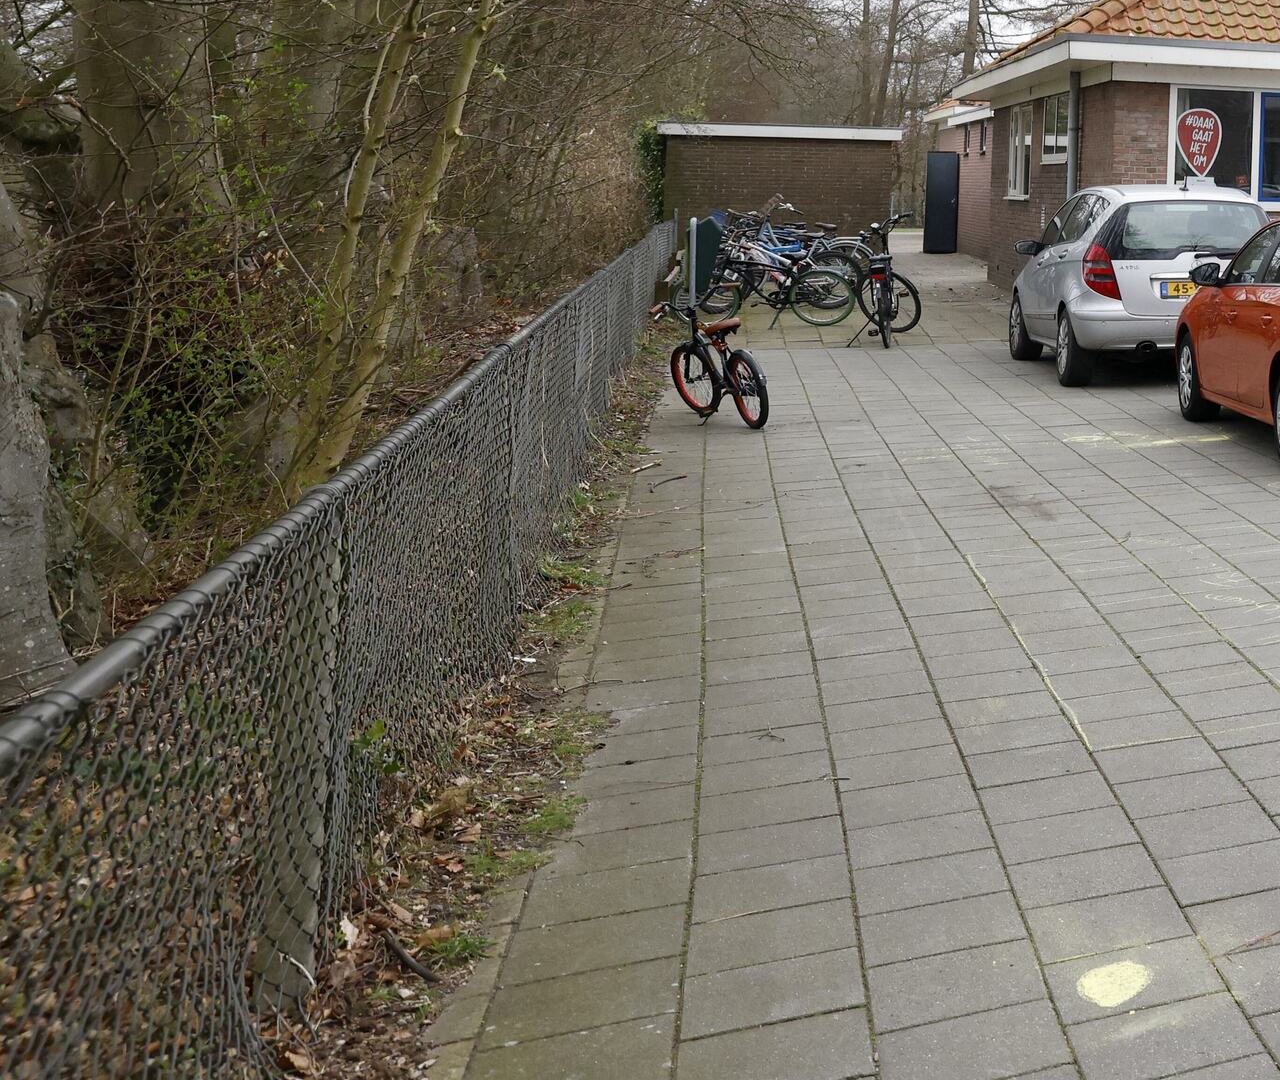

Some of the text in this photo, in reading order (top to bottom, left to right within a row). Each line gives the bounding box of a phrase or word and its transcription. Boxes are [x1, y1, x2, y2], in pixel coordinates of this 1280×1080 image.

[1185, 115, 1215, 130] #DAAR
[1192, 129, 1214, 142] GAAT
[1189, 142, 1208, 155] HET
[1193, 155, 1207, 167] OM
